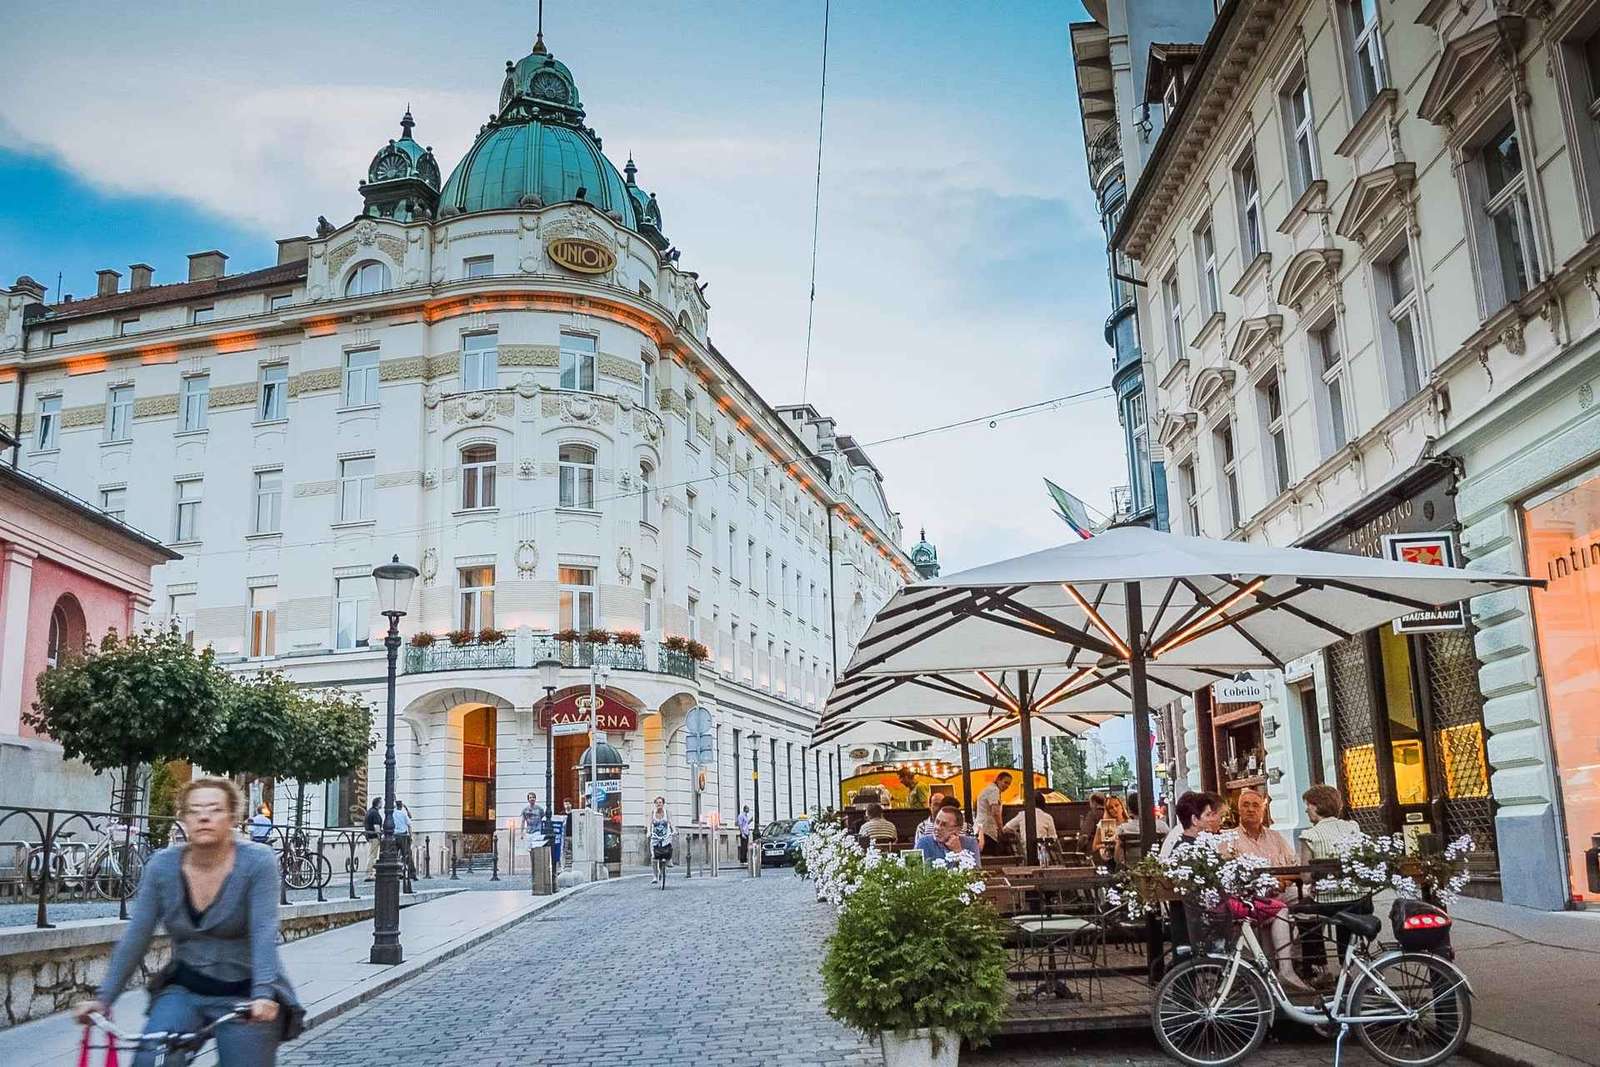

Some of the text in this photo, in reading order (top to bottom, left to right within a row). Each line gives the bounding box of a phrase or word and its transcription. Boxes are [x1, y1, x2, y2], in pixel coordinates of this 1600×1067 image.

[557, 243, 609, 268] UNION
[1348, 500, 1412, 549] ZLATARSTVO
[1402, 610, 1460, 622] HAUSBRANDT
